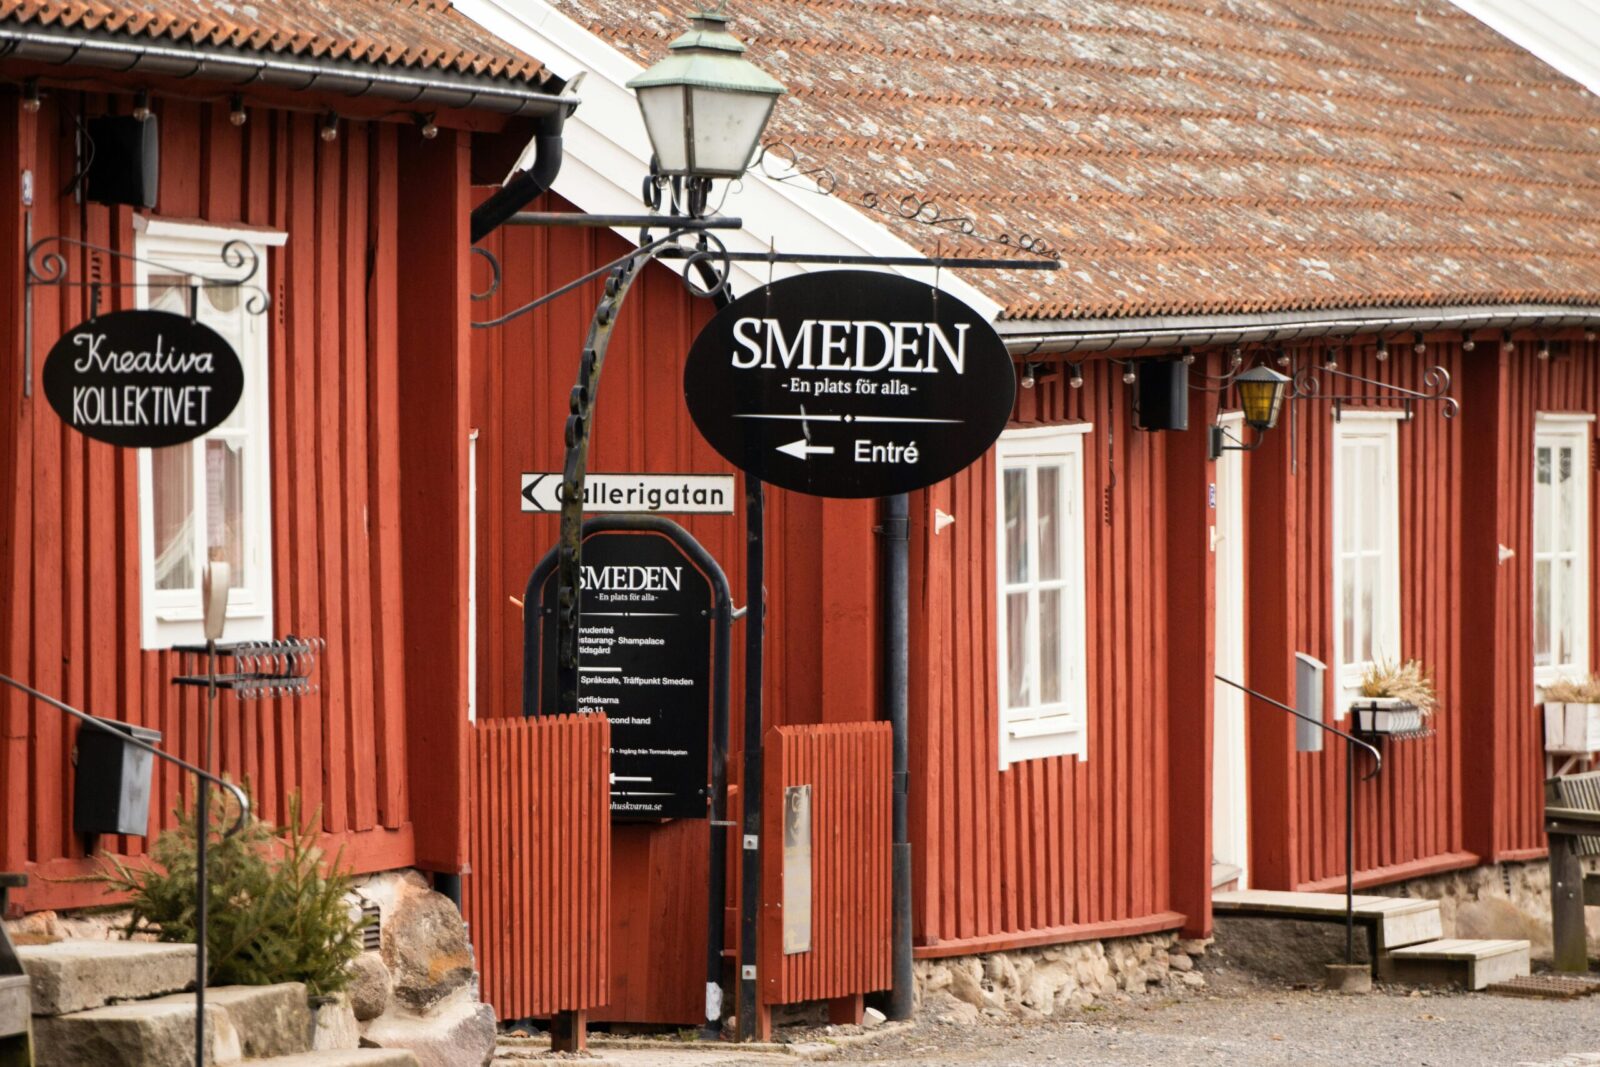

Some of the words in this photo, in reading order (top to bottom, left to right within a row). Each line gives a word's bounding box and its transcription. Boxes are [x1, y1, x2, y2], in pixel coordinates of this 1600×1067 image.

[731, 317, 971, 375] SMEDEN
[73, 333, 215, 373] Kreativa
[814, 377, 852, 396] plats
[855, 379, 878, 395] för
[72, 386, 212, 426] KOLLEKTIVET
[854, 440, 919, 464] Entré
[610, 592, 628, 602] plats
[629, 592, 641, 601] för
[579, 626, 614, 634] vudentré
[579, 636, 616, 645] staurang-
[618, 636, 665, 646] Shampalace
[579, 646, 611, 655] tidsgård
[622, 676, 661, 686] Träffpunkt
[662, 677, 694, 686] Smeden
[578, 696, 619, 704] ortfiskarna
[631, 717, 651, 725] hand
[609, 801, 663, 811] huskvarna.se
